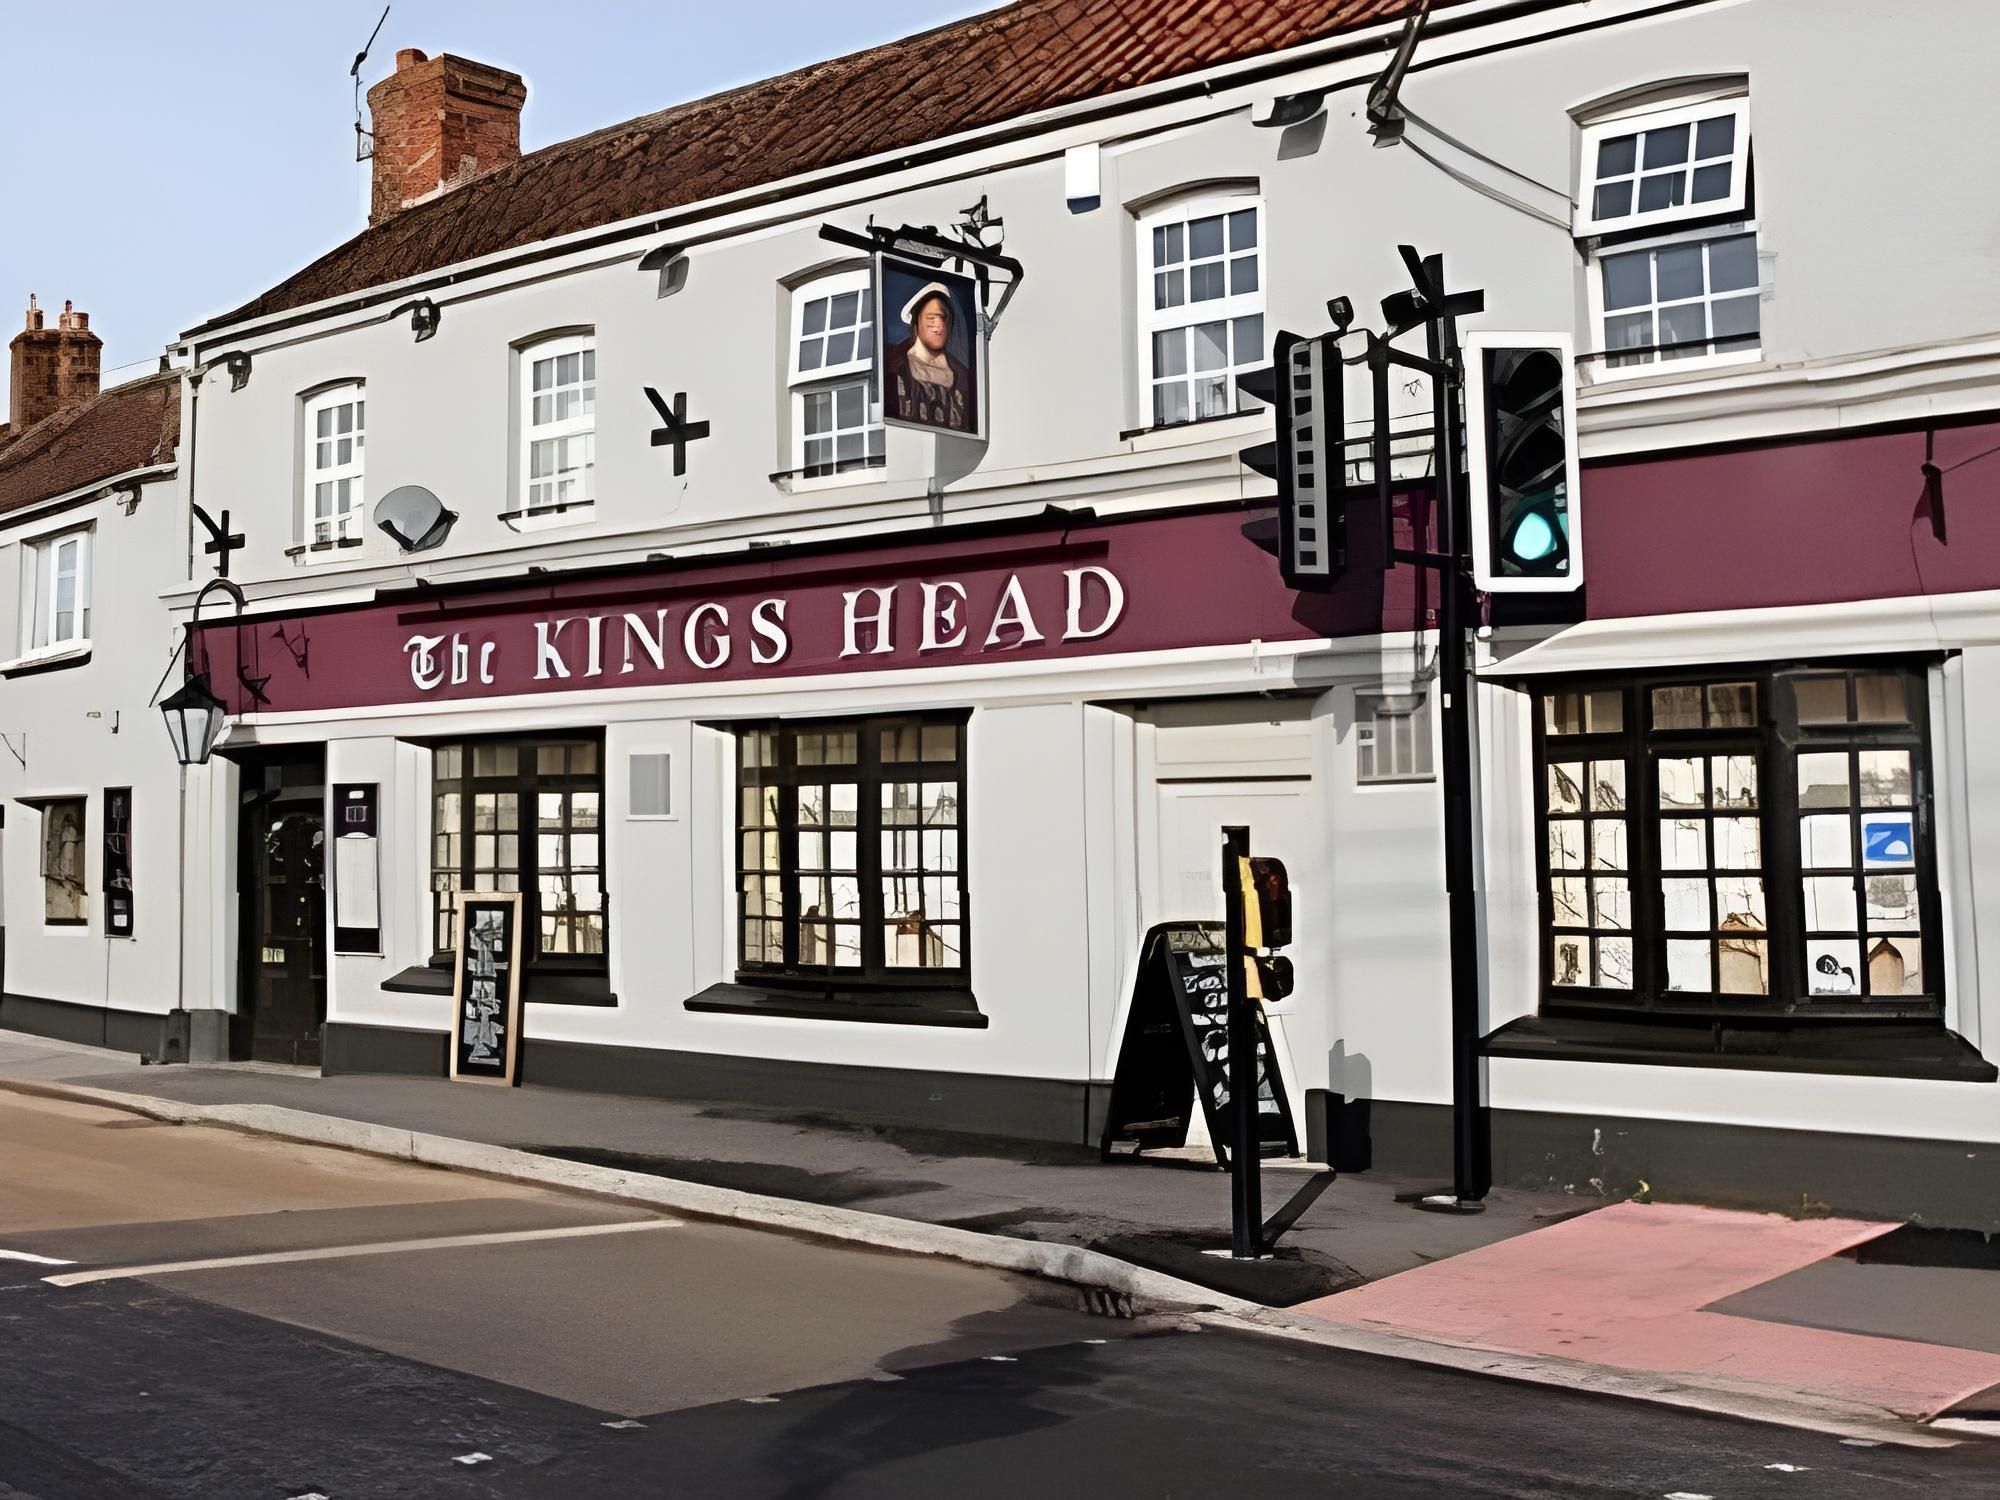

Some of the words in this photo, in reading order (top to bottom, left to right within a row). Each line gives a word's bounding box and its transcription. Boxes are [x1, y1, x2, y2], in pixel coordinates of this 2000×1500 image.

[403, 634, 496, 690] The
[532, 599, 787, 680] KINGS
[838, 566, 1124, 659] HEAD
